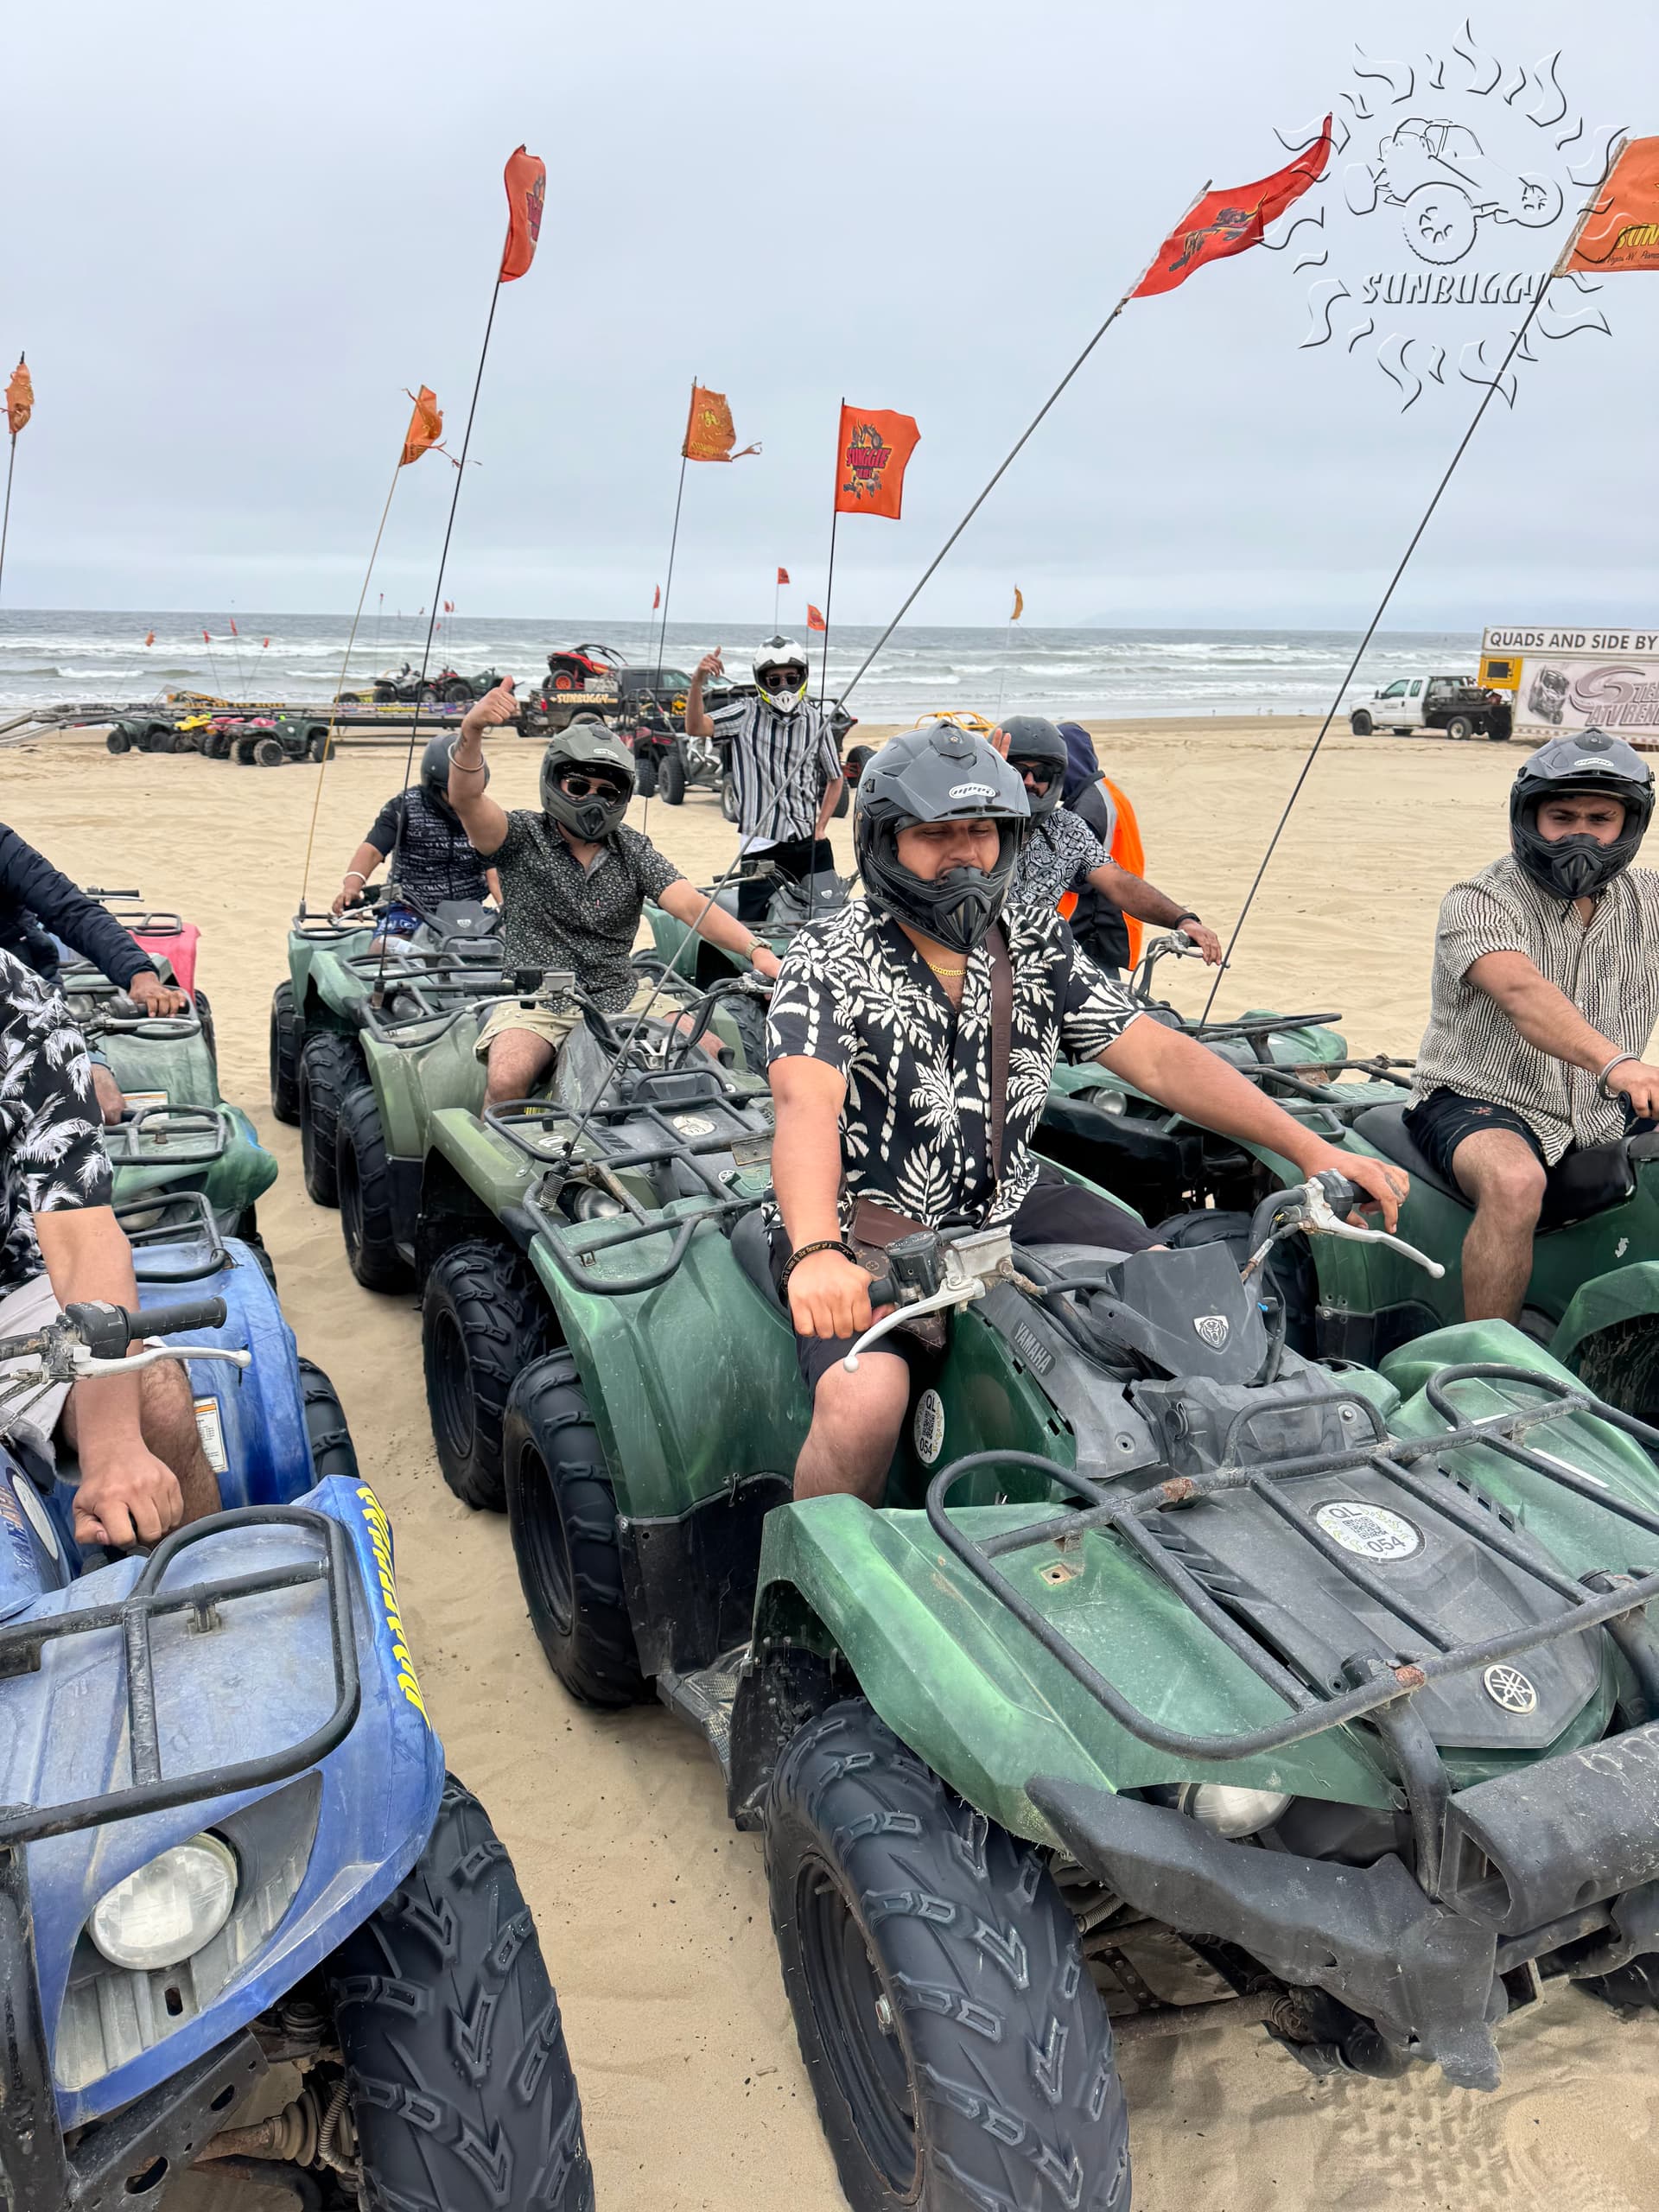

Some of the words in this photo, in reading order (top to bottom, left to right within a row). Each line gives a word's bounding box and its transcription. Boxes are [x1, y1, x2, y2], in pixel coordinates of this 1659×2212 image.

[1490, 632, 1544, 647] QUADS
[1548, 633, 1586, 648] AND
[1592, 634, 1630, 649] SIDE
[1635, 635, 1658, 651] BY
[1585, 703, 1624, 727] ATV
[1013, 1323, 1053, 1375] YAMAHA
[926, 1395, 936, 1413] QL
[920, 1437, 933, 1456] 054
[1328, 1506, 1363, 1519] QL
[1366, 1535, 1407, 1553] 054
